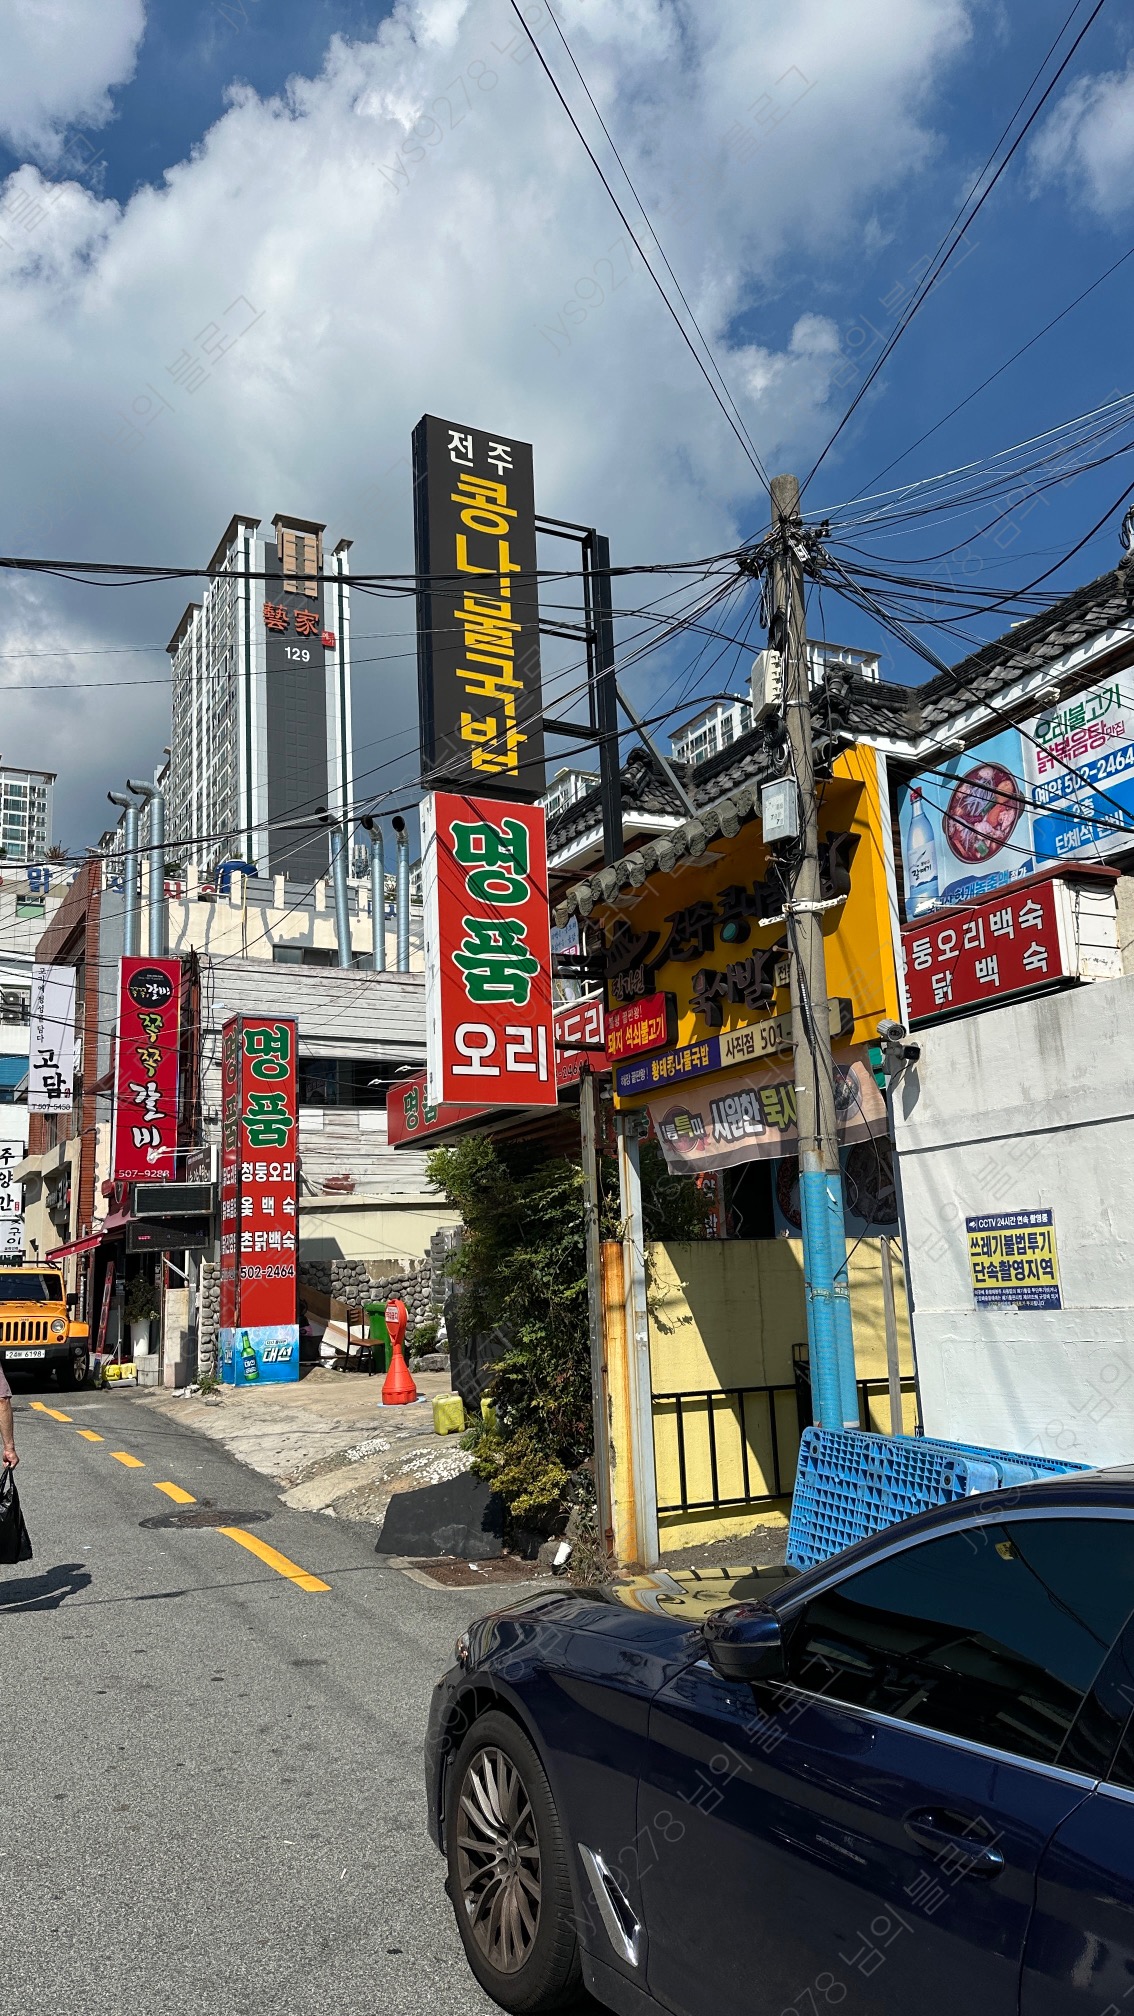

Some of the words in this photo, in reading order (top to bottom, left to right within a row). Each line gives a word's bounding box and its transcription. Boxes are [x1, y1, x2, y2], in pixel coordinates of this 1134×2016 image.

[448, 429, 513, 475] 전주
[451, 472, 528, 777] 콩나물국밥
[284, 646, 310, 662] 129
[1034, 683, 1121, 747] 오리불고기
[1035, 777, 1063, 806] 예약
[1064, 746, 1134, 794] 502-2464
[449, 817, 540, 1006] 명품
[451, 1022, 548, 1082] 오리
[608, 1028, 623, 1055] 돼지
[625, 1013, 665, 1049] 석쇠불고기
[725, 1031, 755, 1060] 사직점
[33, 1048, 66, 1100] 고담
[651, 1043, 709, 1082] 황태콩나물국밥
[243, 1023, 294, 1148] 명품
[711, 1091, 764, 1140] 시원한
[241, 1162, 295, 1182] 청둥오리
[240, 1231, 295, 1252] 촌닭백숙
[979, 1218, 997, 1228] CCTV
[997, 1216, 1016, 1227] 24시간
[970, 1230, 1052, 1258] 쓰레기불법투기
[240, 1264, 295, 1280] 502-2464
[972, 1257, 1055, 1283] 단속촬영지역
[262, 1345, 293, 1363] 대선
